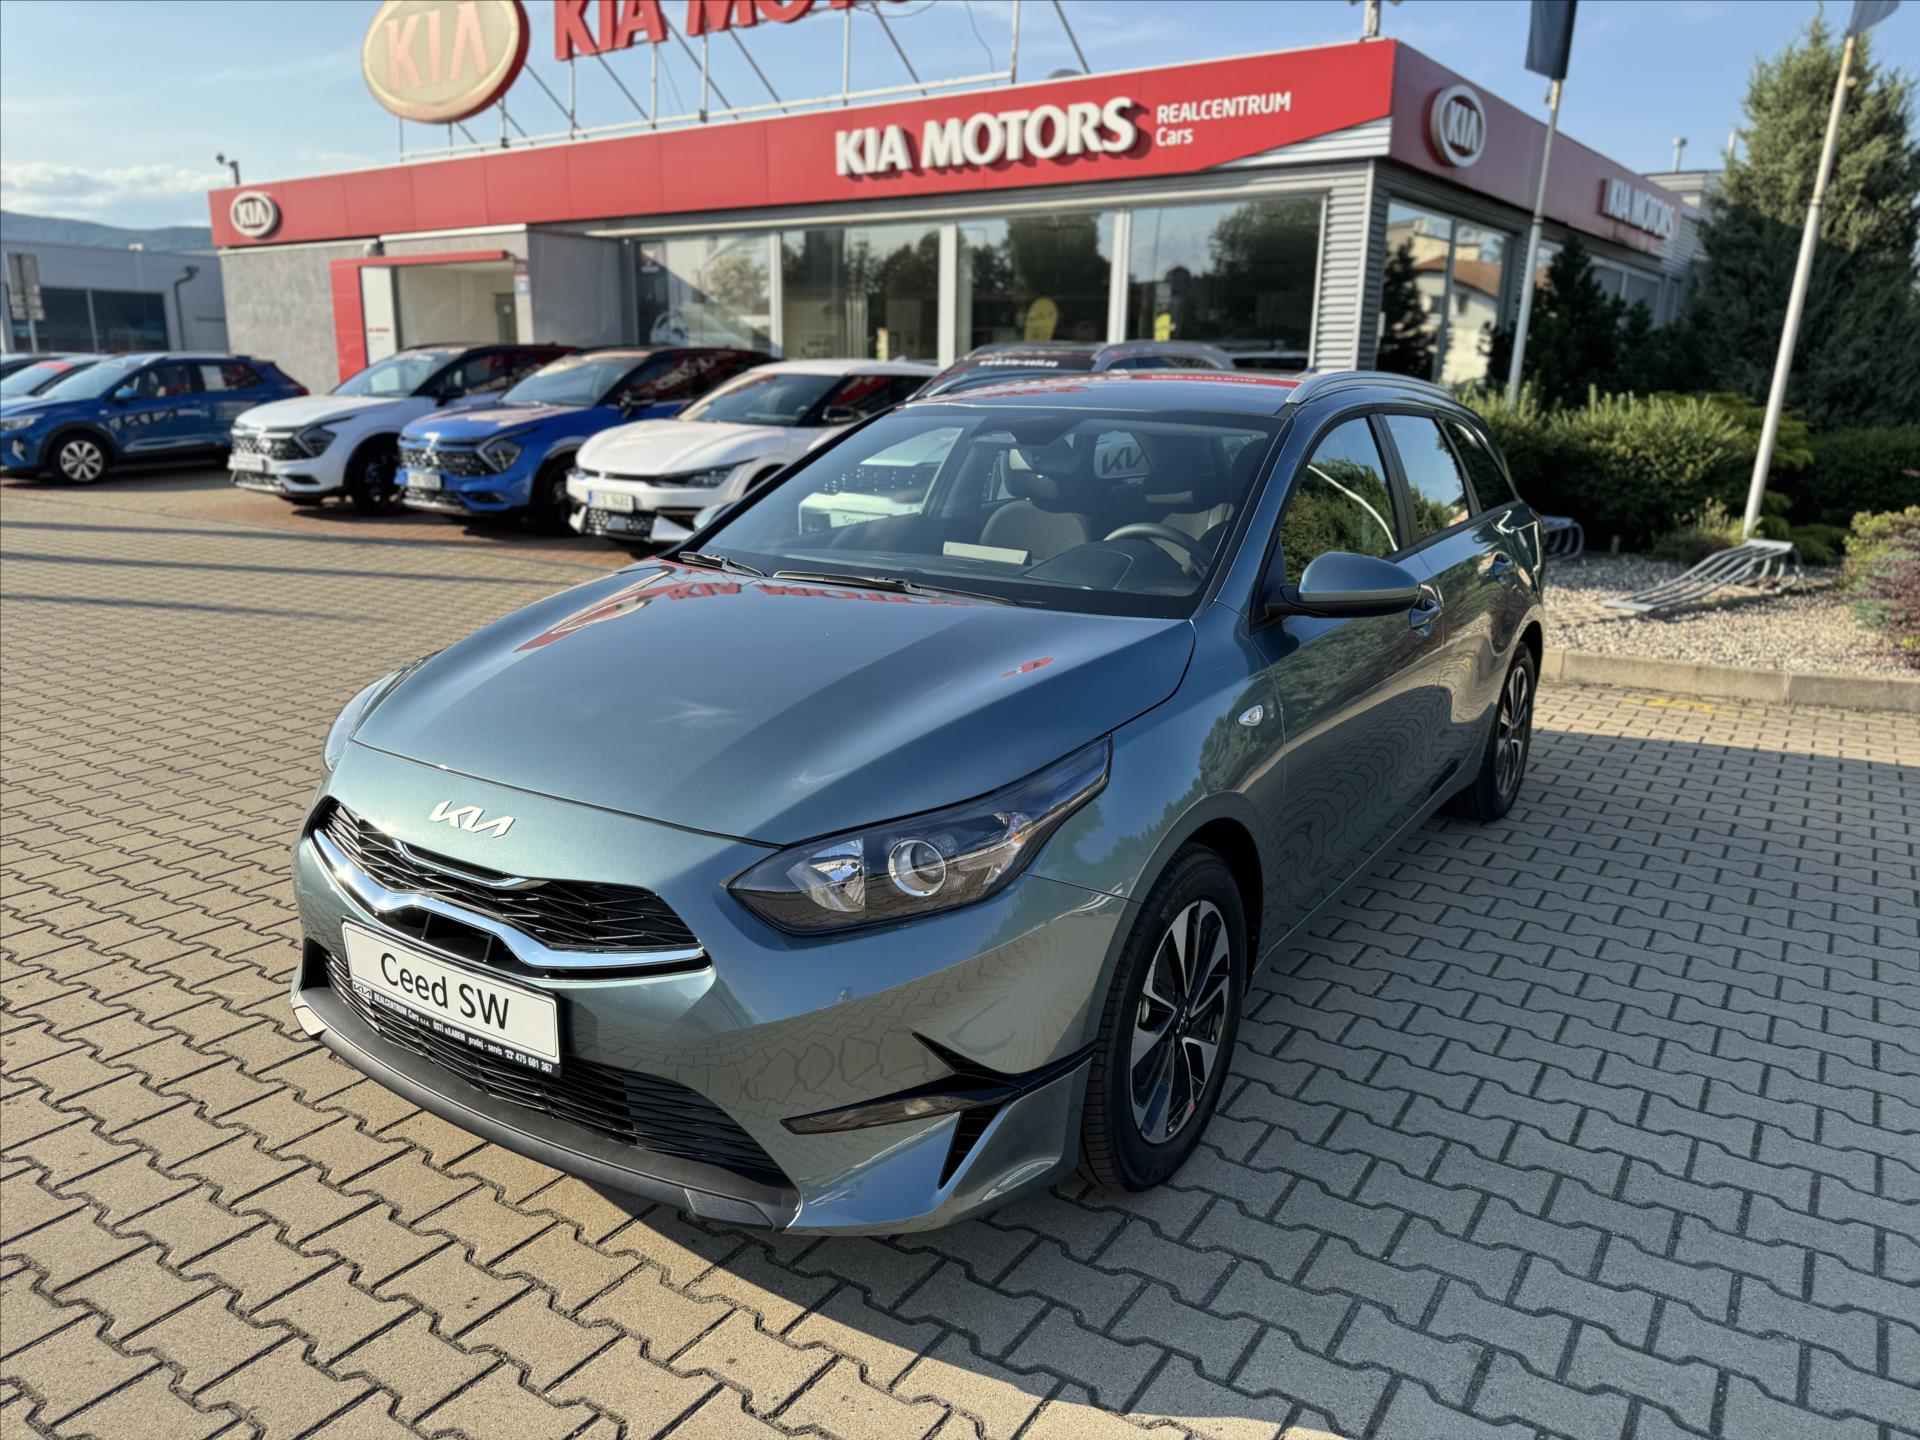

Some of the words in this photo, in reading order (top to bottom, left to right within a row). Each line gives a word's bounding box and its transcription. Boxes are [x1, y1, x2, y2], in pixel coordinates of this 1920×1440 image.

[385, 1, 490, 91] KIA
[835, 126, 913, 176] KIA
[920, 97, 1138, 168] MOTORS
[1156, 91, 1292, 125] REALCENTRUM
[1447, 100, 1478, 152] KIA
[1156, 127, 1195, 148] Cars
[237, 201, 269, 226] KIA
[1607, 178, 1631, 222] KIA
[1629, 189, 1677, 240] MOTORS
[428, 800, 516, 838] KIA
[380, 952, 449, 1009] Ceed
[458, 983, 509, 1030] SW
[353, 983, 372, 998] KIA
[515, 1052, 527, 1064] 475
[528, 1056, 540, 1069] 601
[541, 1061, 553, 1073] 367
